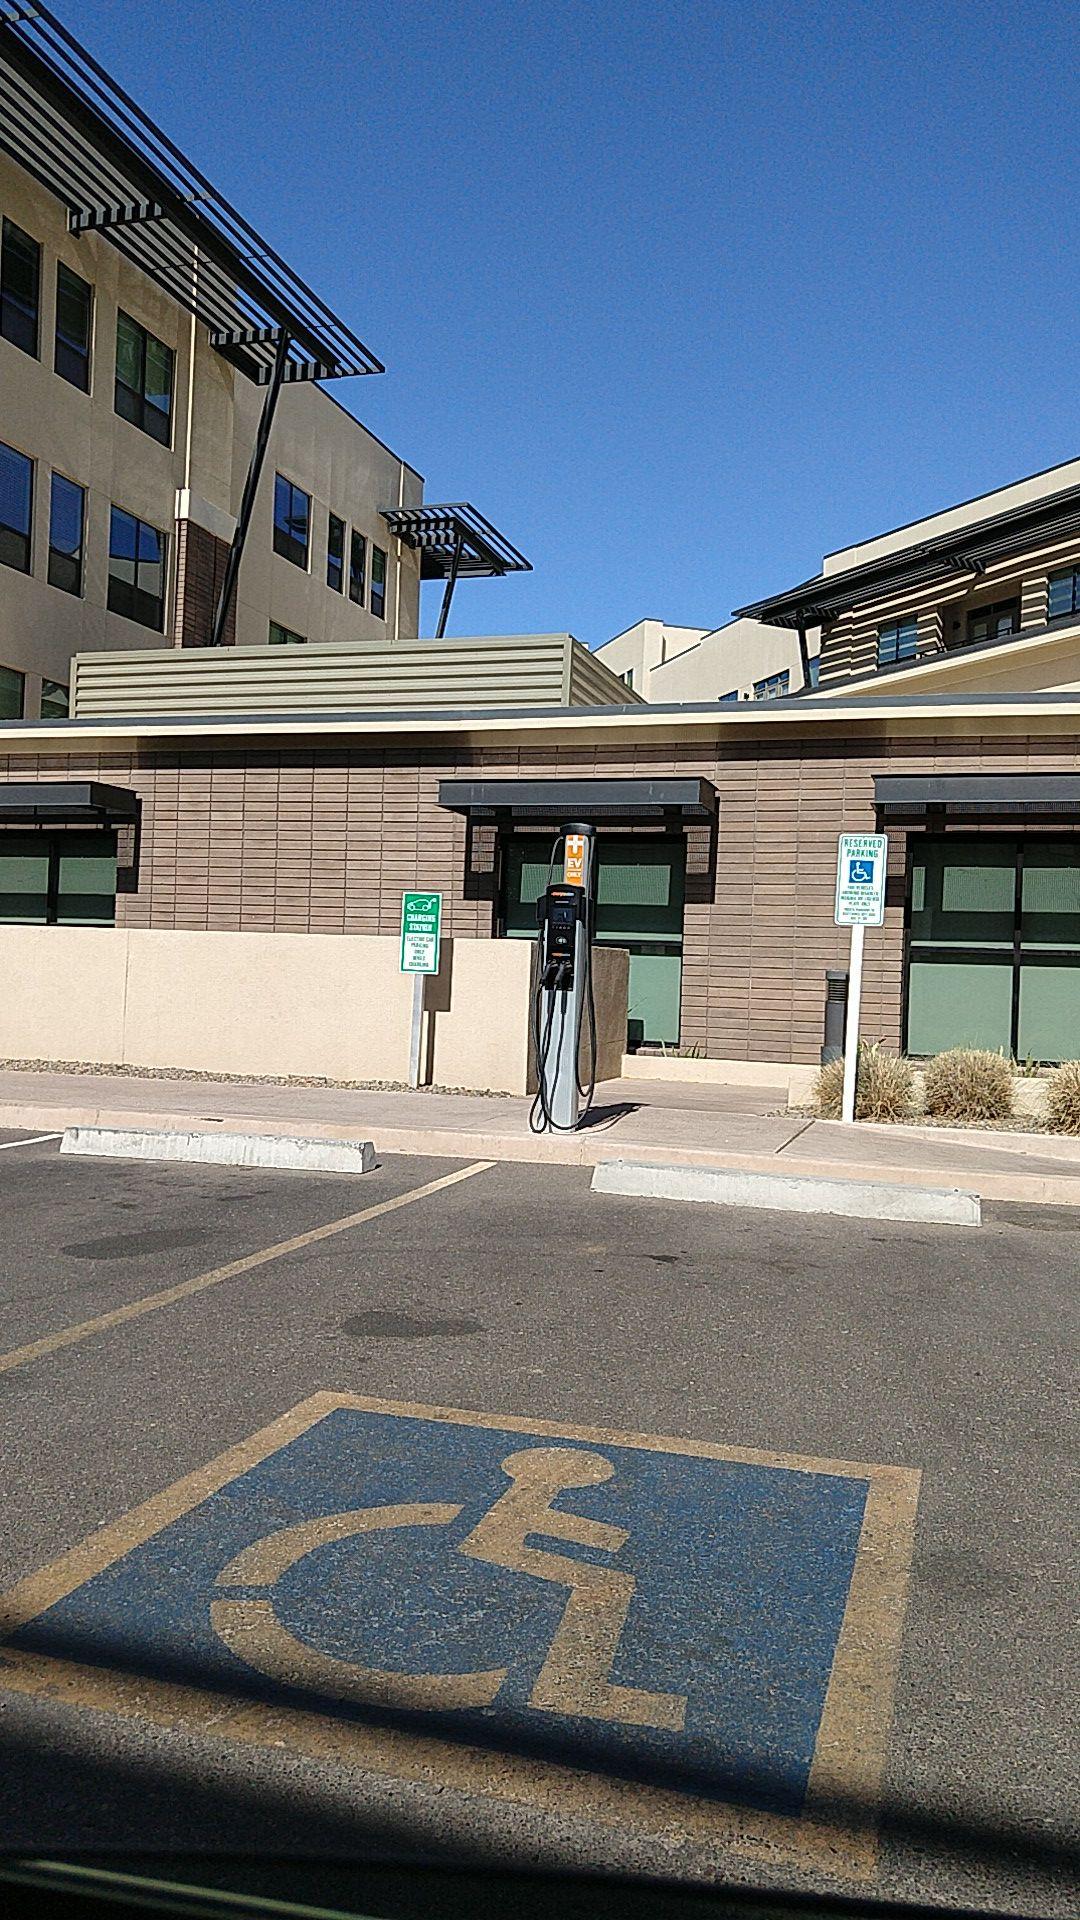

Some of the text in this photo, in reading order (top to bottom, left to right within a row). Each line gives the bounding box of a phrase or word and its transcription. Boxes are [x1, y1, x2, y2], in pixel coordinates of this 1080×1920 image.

[844, 839, 882, 848] RESERVED
[847, 849, 878, 857] PARKING
[567, 858, 582, 868] EV
[407, 914, 436, 922] CHARGING
